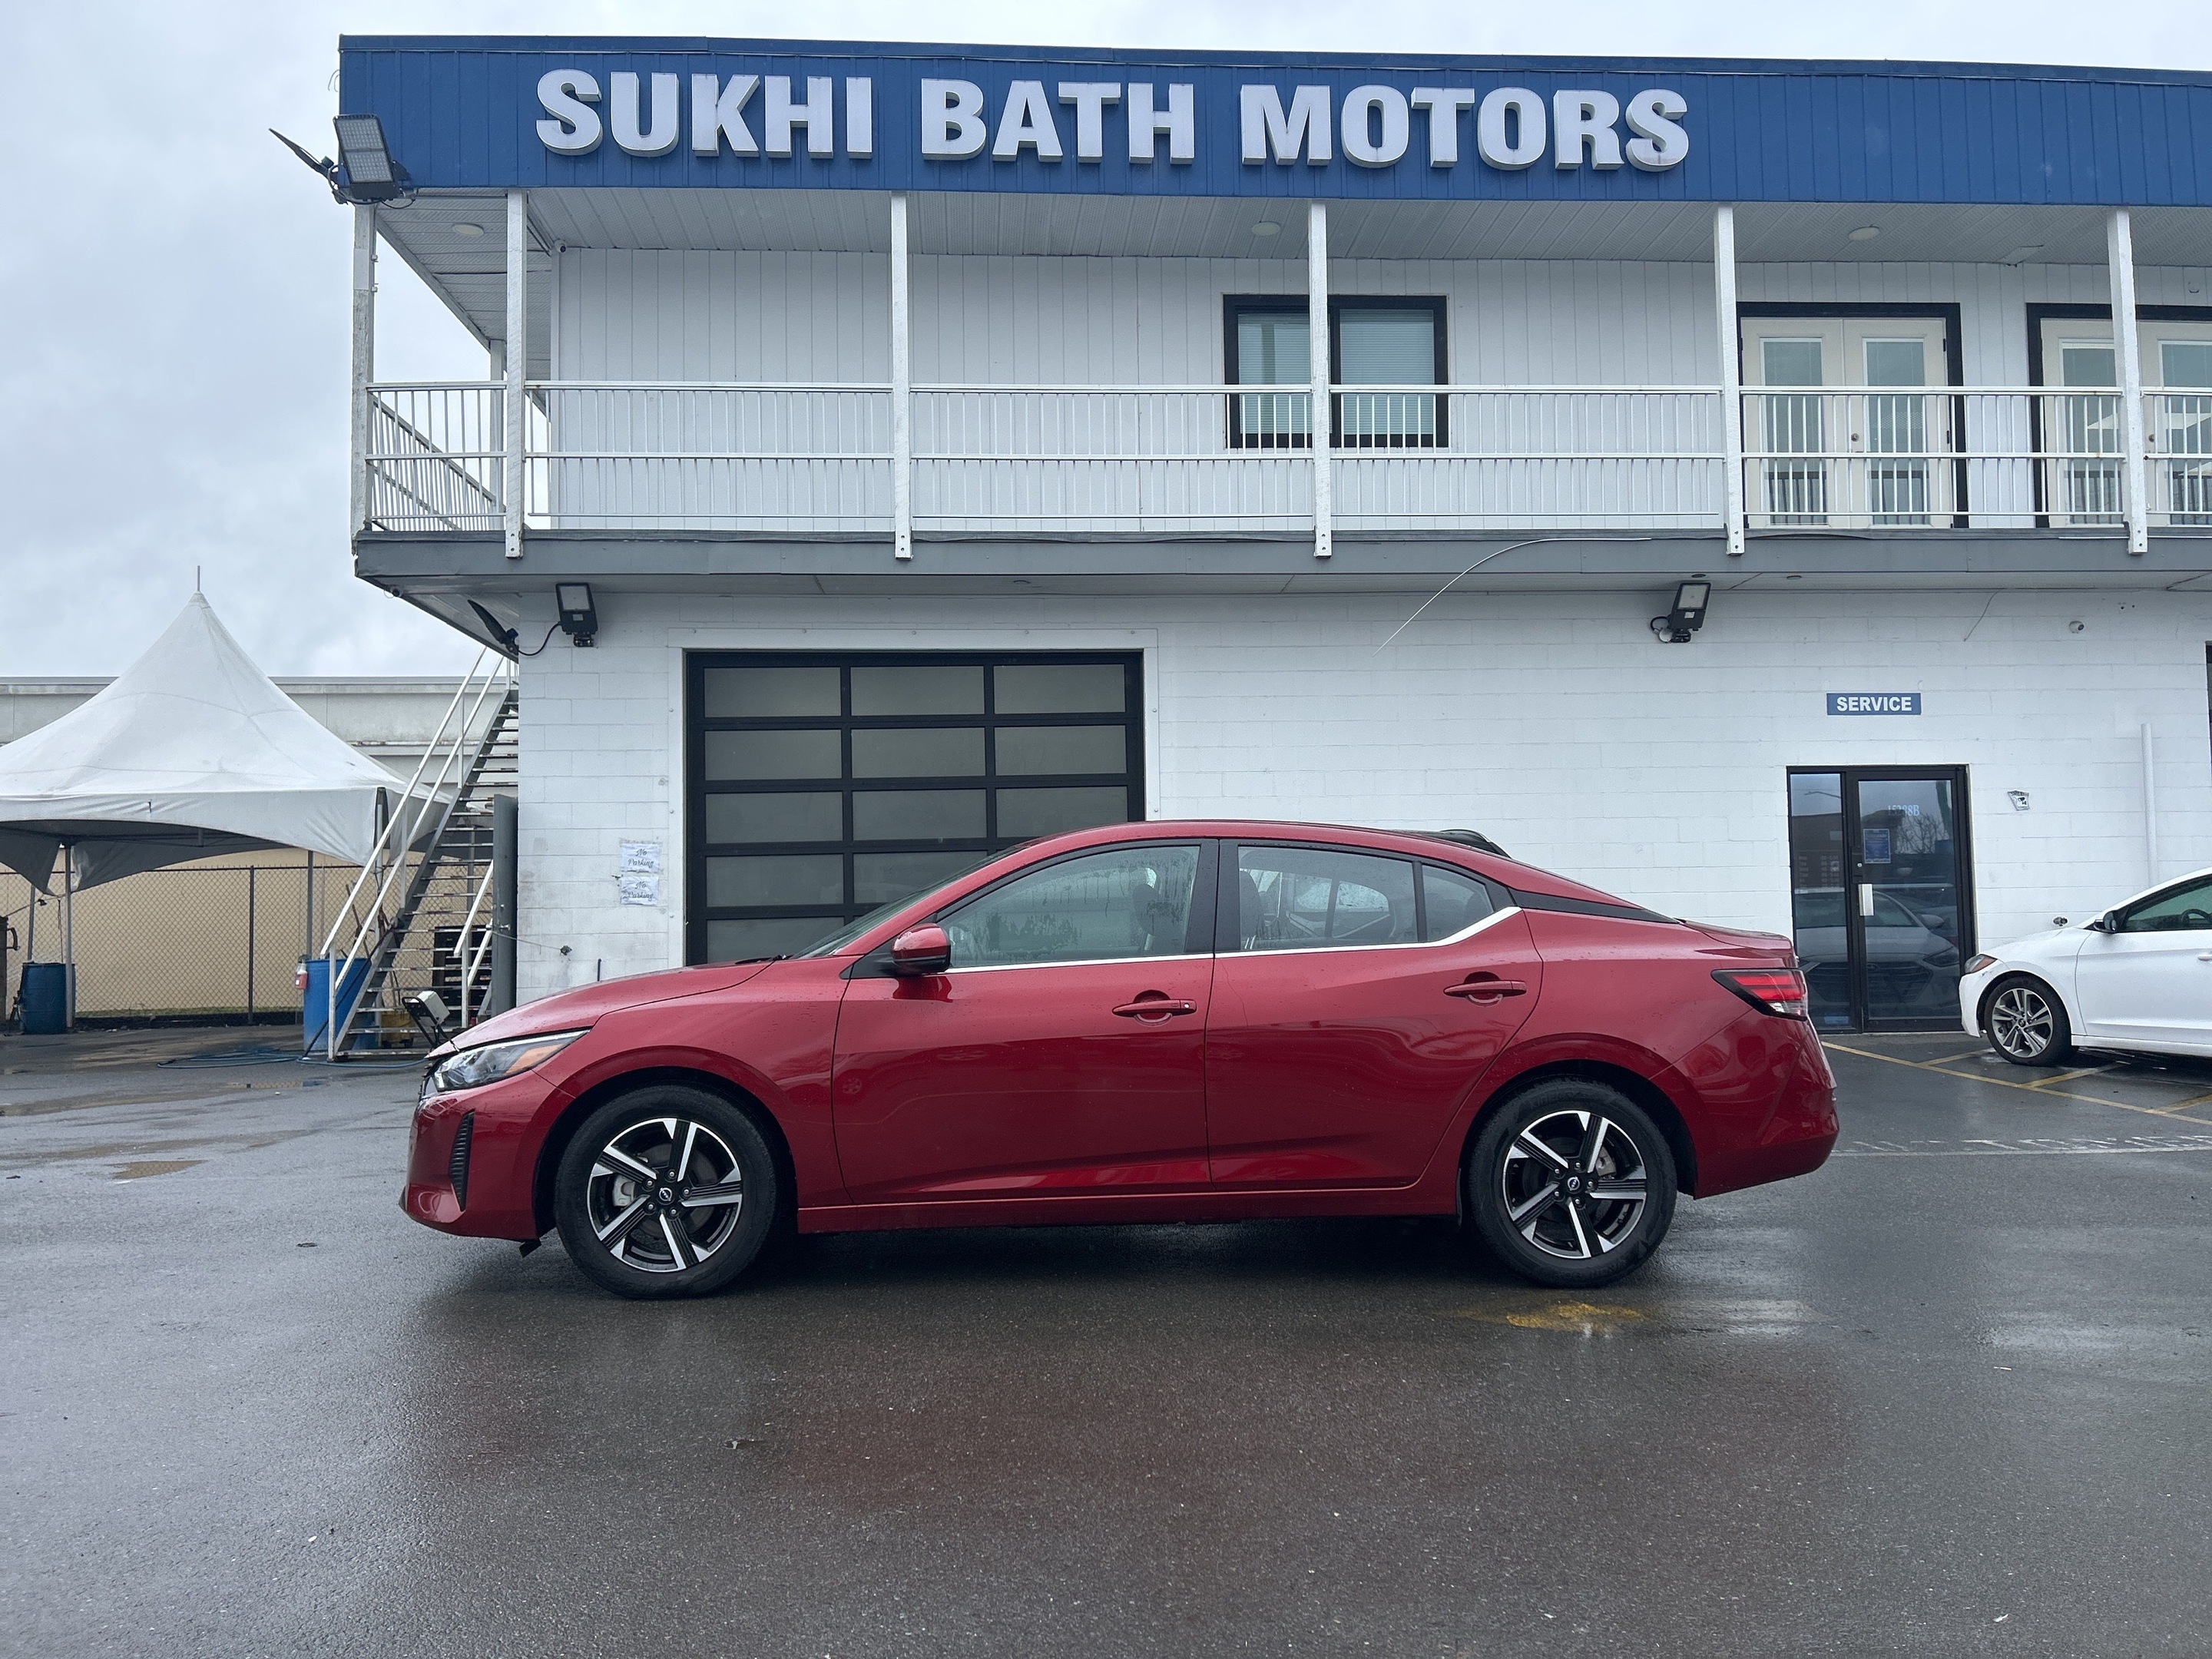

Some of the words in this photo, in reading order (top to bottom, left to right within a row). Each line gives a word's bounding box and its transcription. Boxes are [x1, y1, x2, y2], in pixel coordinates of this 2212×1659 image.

[536, 68, 873, 160] SUKHI
[922, 78, 1194, 165] BATH
[1240, 84, 1690, 172] MOTORS
[1836, 696, 1912, 711] SERVICE
[635, 848, 647, 856] No
[628, 859, 654, 869] Parking
[635, 881, 647, 889] No
[628, 891, 654, 902] Parking
